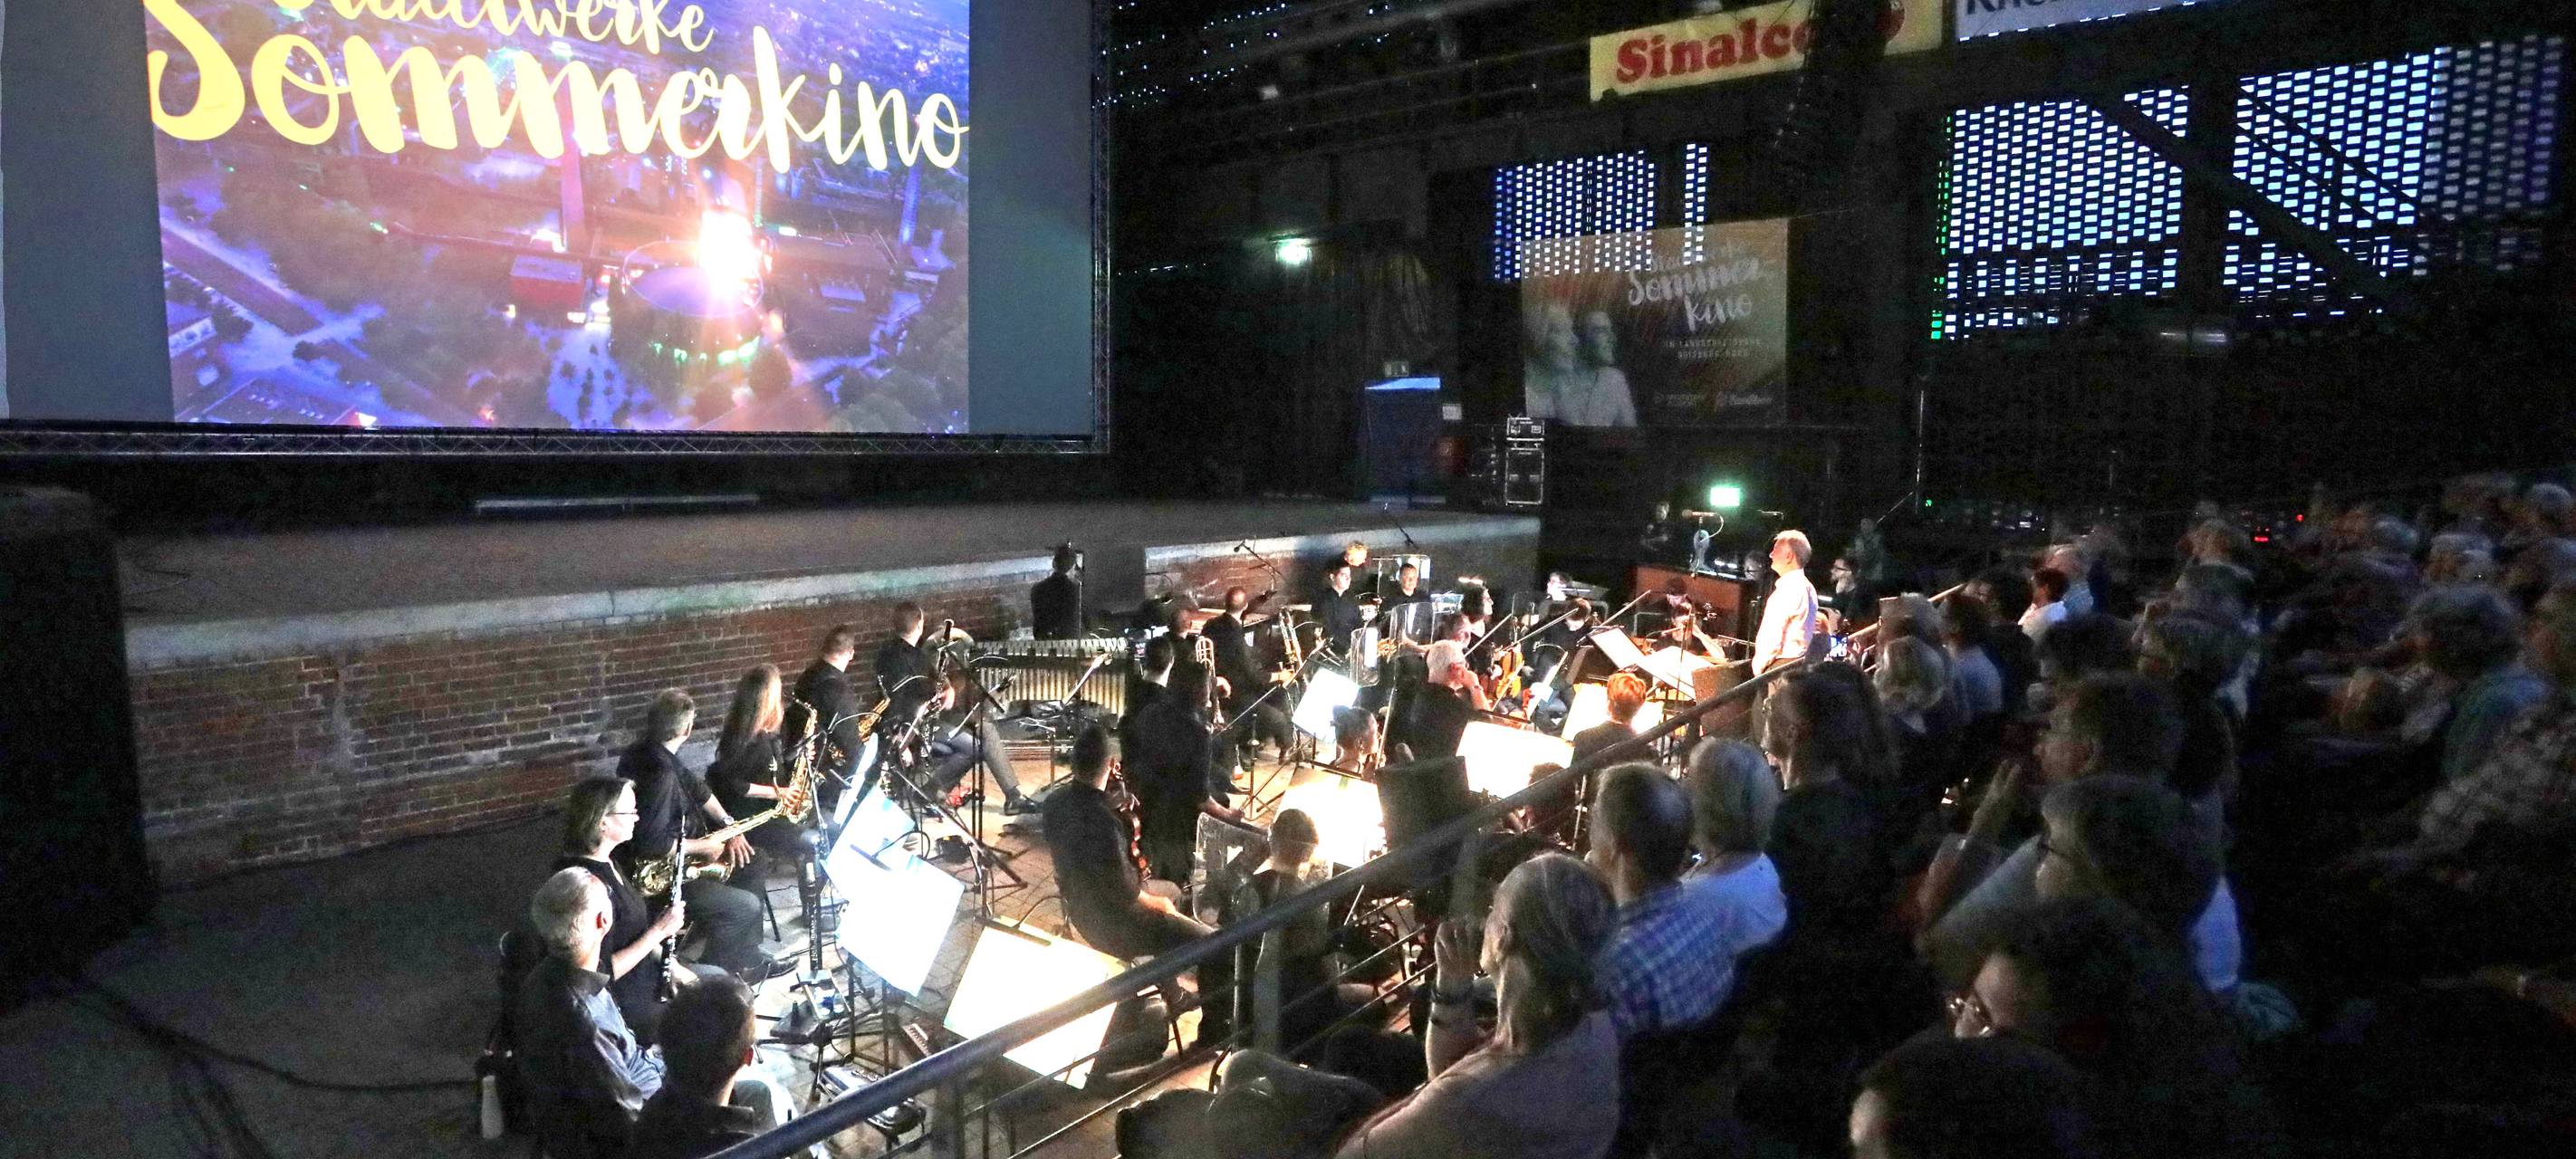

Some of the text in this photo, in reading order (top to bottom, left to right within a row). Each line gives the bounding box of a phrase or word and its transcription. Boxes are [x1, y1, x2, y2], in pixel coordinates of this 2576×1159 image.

[274, 0, 714, 54] werke
[148, 0, 970, 174] Sommerkino
[1677, 349, 1750, 359] DUISBURGNORD
